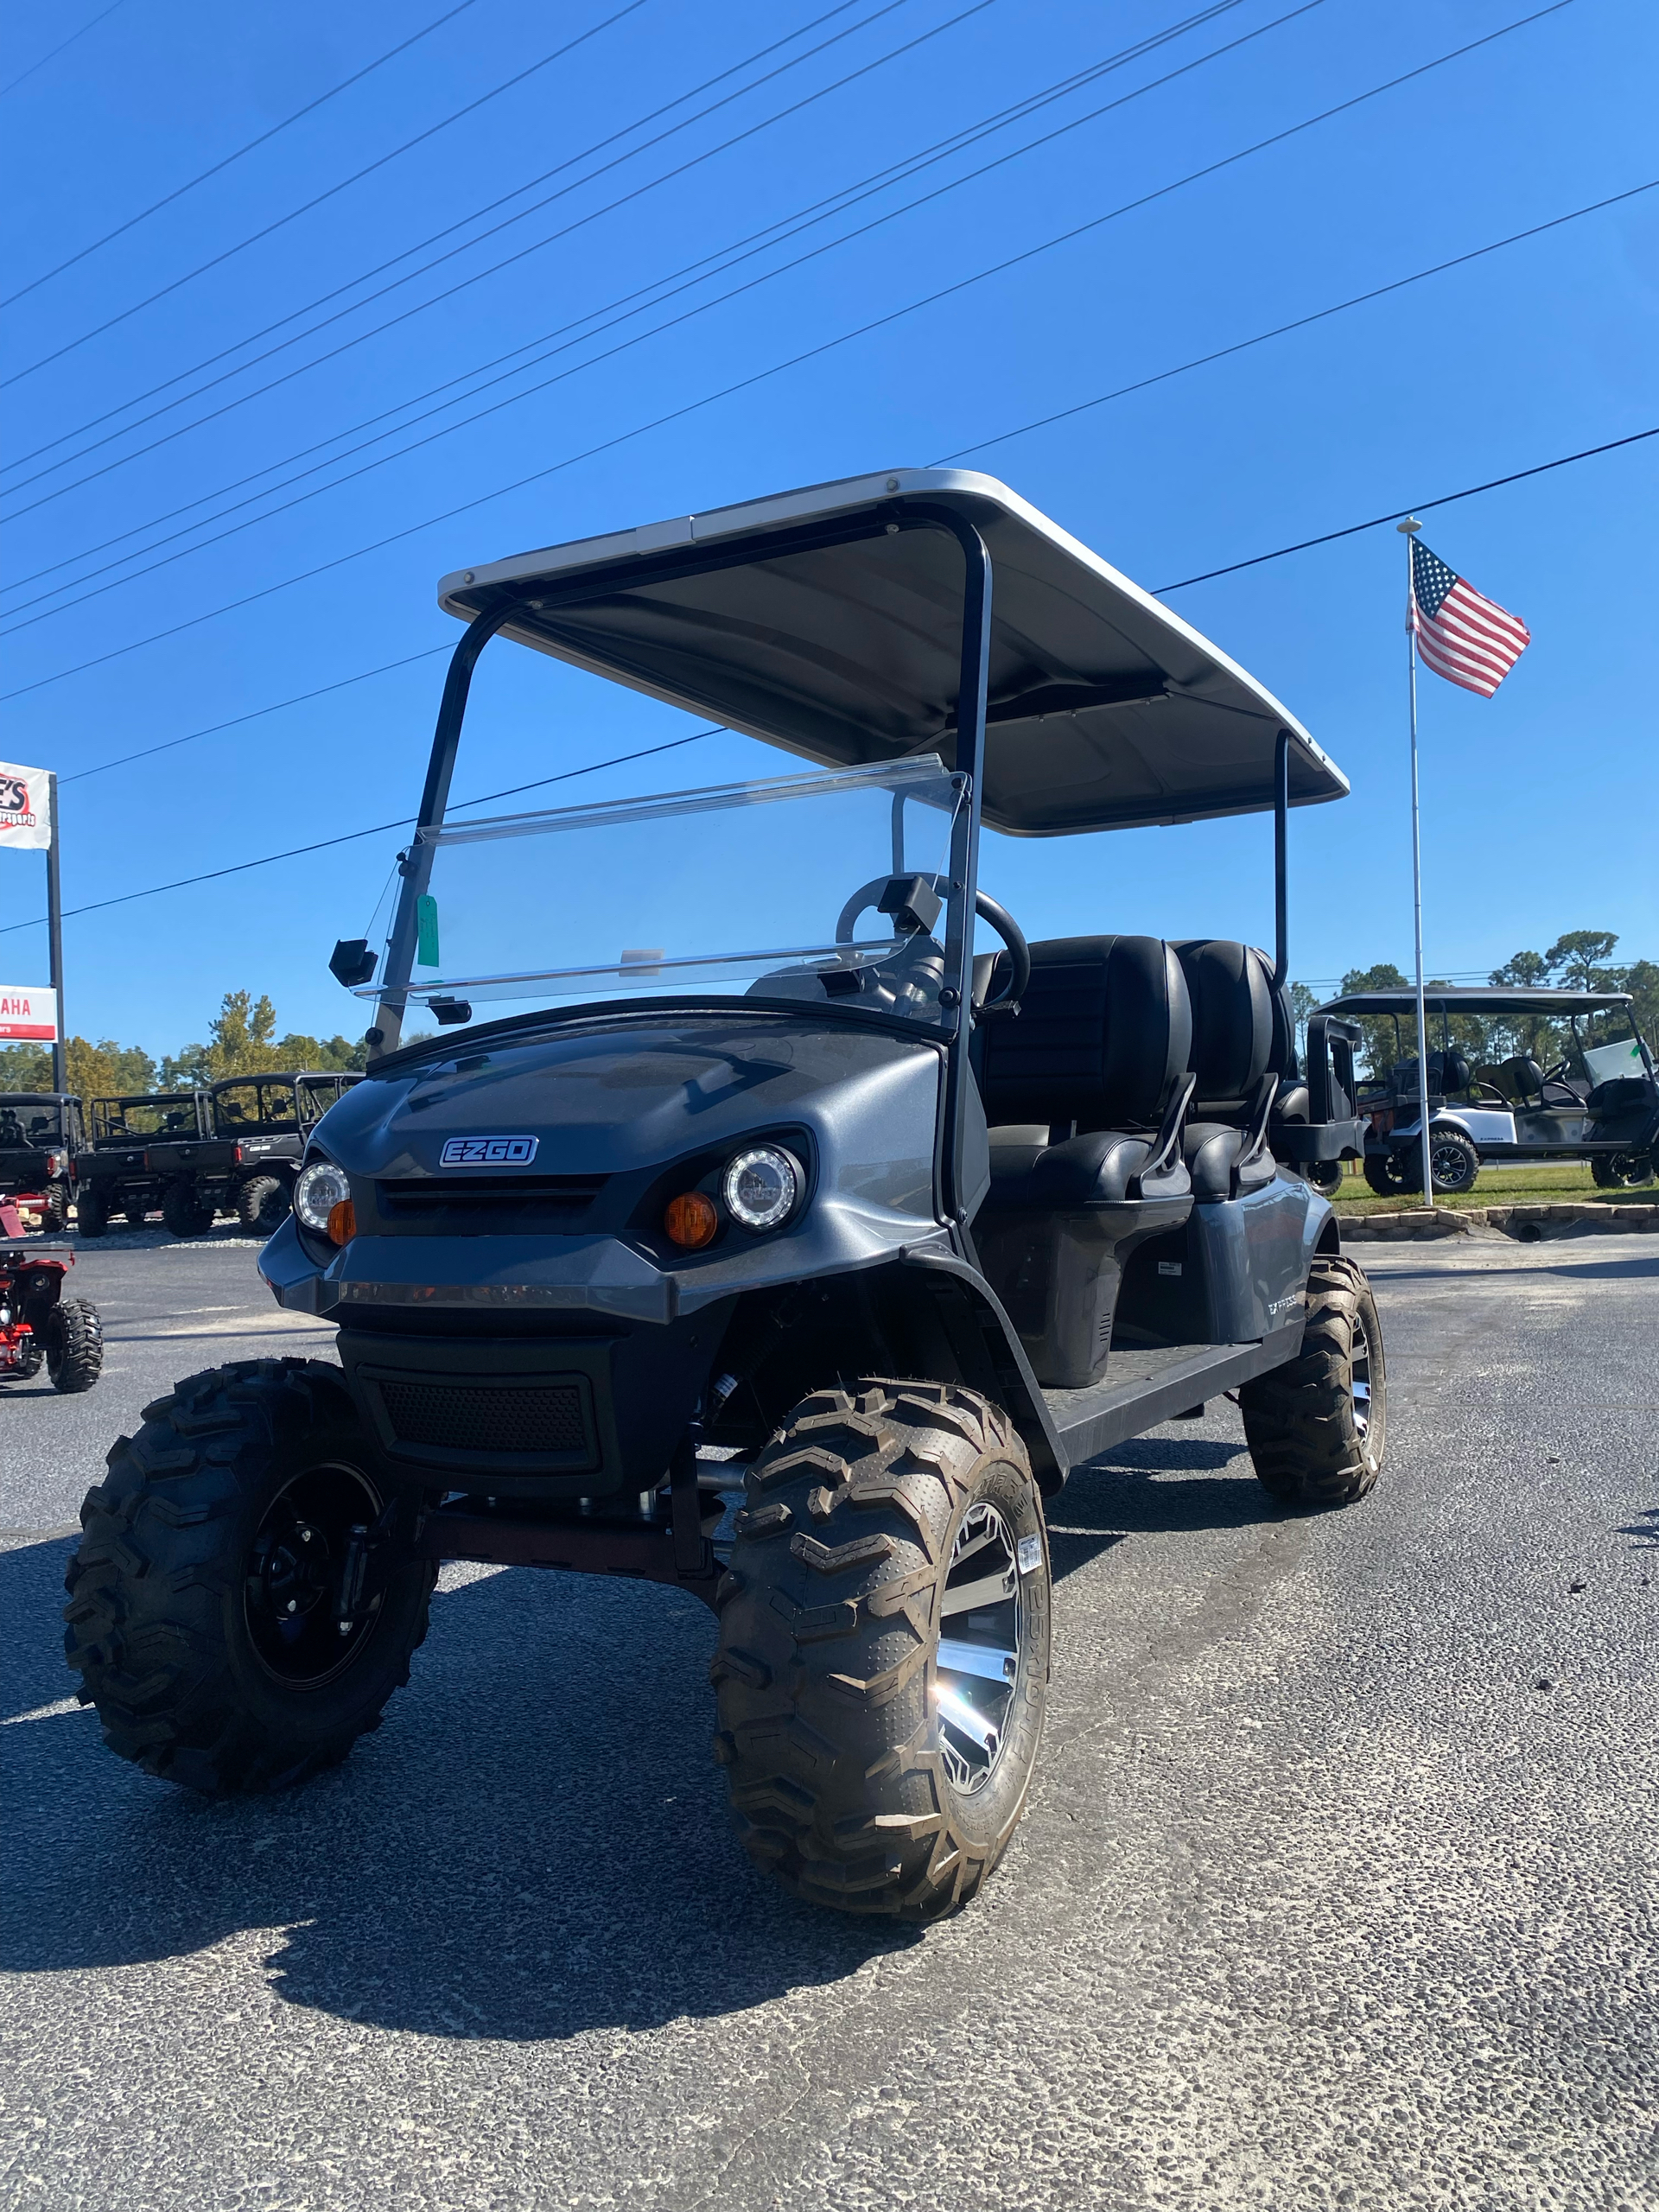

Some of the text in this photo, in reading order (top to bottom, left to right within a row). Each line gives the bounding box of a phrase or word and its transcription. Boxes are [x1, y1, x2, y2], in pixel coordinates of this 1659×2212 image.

[0, 812, 35, 827] rsports
[444, 1141, 531, 1160] EZGO
[1268, 1294, 1298, 1316] EXPRESS
